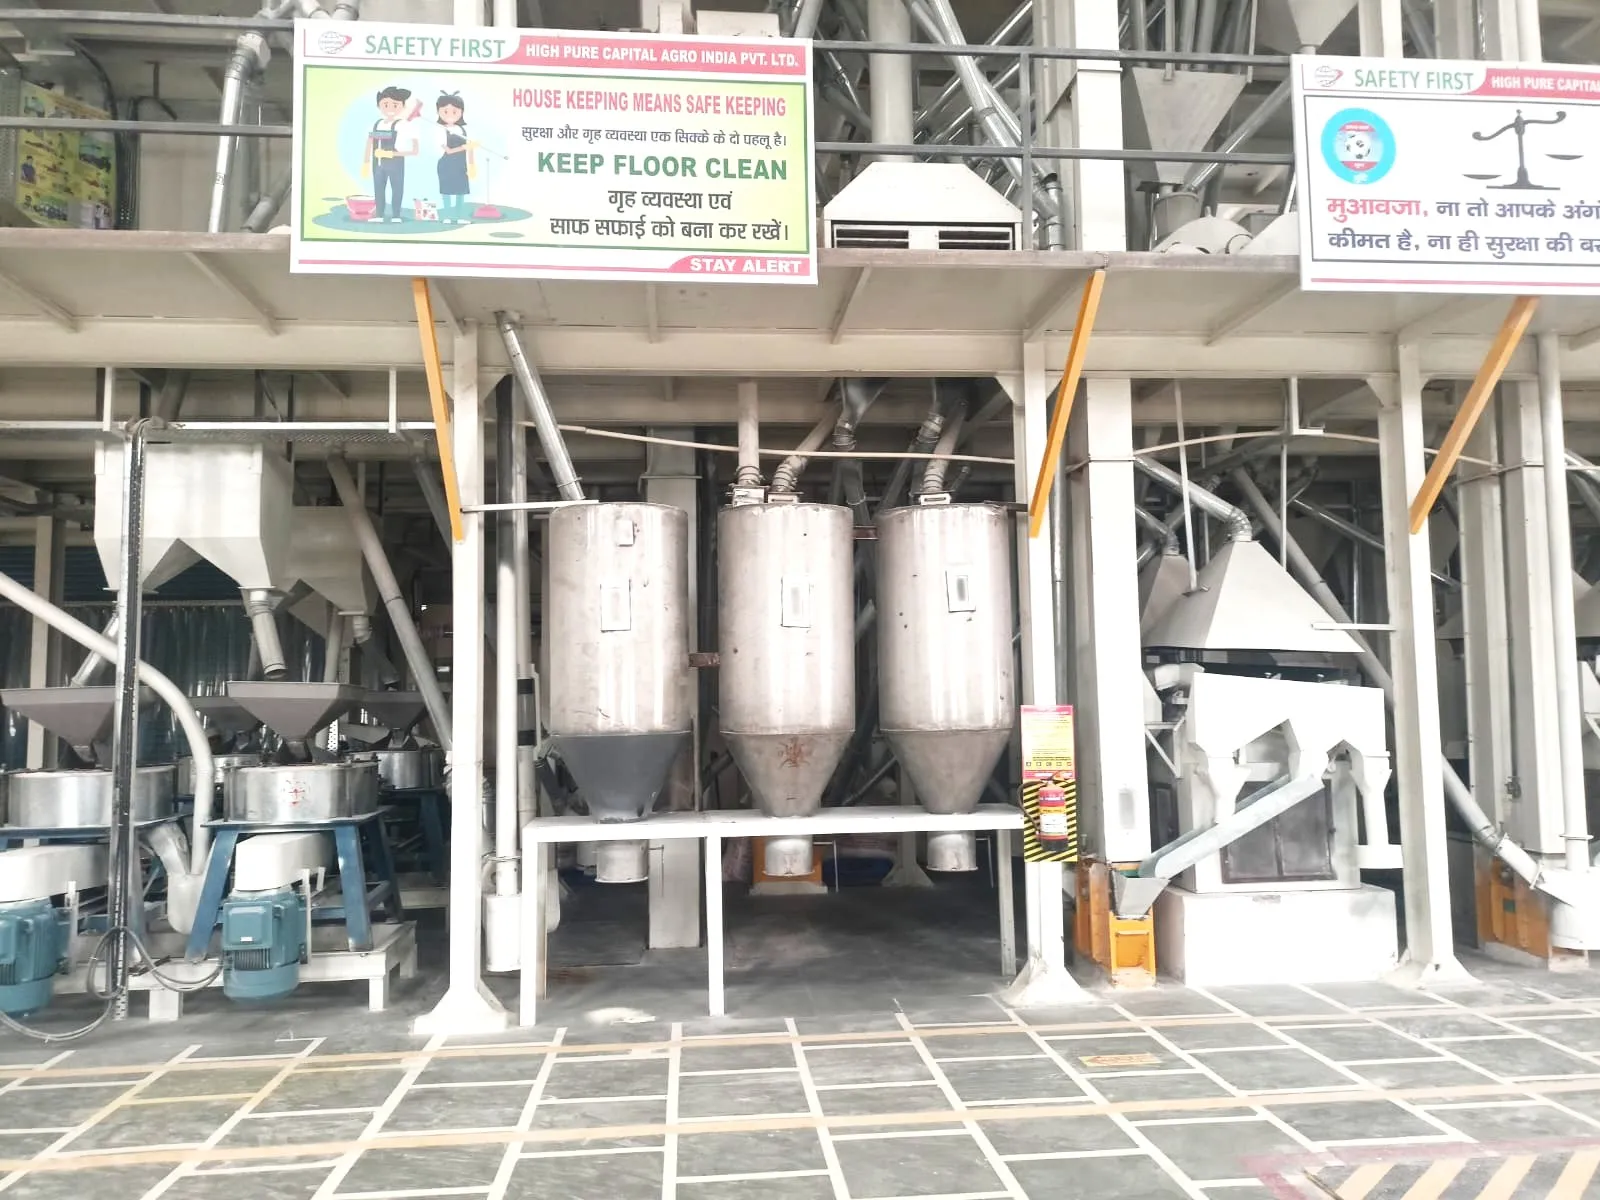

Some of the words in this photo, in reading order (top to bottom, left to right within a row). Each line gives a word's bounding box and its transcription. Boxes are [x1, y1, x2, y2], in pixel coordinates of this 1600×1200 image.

[365, 35, 442, 56] SAFETY
[450, 38, 506, 58] FIRST
[526, 44, 559, 58] HIGH
[563, 46, 599, 59] PURE
[603, 47, 658, 62] CAPITAL
[661, 50, 697, 63] AGRO
[701, 51, 736, 65] INDIA
[740, 52, 768, 66] PVT.
[771, 53, 799, 67] LTD.
[1354, 69, 1420, 89] SAFETY
[1426, 71, 1474, 90] FIRST
[1491, 75, 1521, 89] HIGH
[1523, 77, 1556, 90] PURE
[512, 88, 562, 109] HOUSE
[566, 90, 629, 112] KEEPING
[633, 92, 682, 114] MEANS
[686, 95, 721, 115] SAFE
[725, 96, 786, 117] KEEPING
[522, 126, 553, 141] सुरक्षा
[557, 124, 579, 139] और
[582, 128, 602, 144] गृह
[605, 129, 647, 142] व्यवस्था
[650, 131, 671, 143] एक
[675, 128, 709, 144] सिक्के
[713, 129, 727, 144] के
[729, 129, 741, 145] दो
[743, 133, 772, 150] पहलू
[538, 152, 604, 174] KEEP
[614, 155, 698, 177] FLOOR
[705, 157, 787, 180] CLEAN
[607, 190, 636, 213] गृह
[641, 191, 703, 209] व्यवस्था
[708, 190, 732, 210] एवं
[1326, 198, 1428, 223] मुआवजा,
[1436, 201, 1460, 217] ना
[1467, 197, 1489, 217] तो
[1495, 198, 1556, 218] आपके
[550, 218, 589, 235] साफ
[595, 215, 646, 239] सफाई
[651, 216, 675, 238] को
[681, 221, 713, 239] बना
[719, 222, 747, 239] कर
[1328, 227, 1390, 249] कीमत
[1397, 229, 1420, 251] है,
[1427, 234, 1452, 250] ना
[1458, 230, 1480, 251] ही
[1485, 236, 1540, 259] सुरक्षा
[1545, 232, 1574, 252] की
[690, 258, 737, 272] STAY
[743, 259, 802, 273] ALERT
